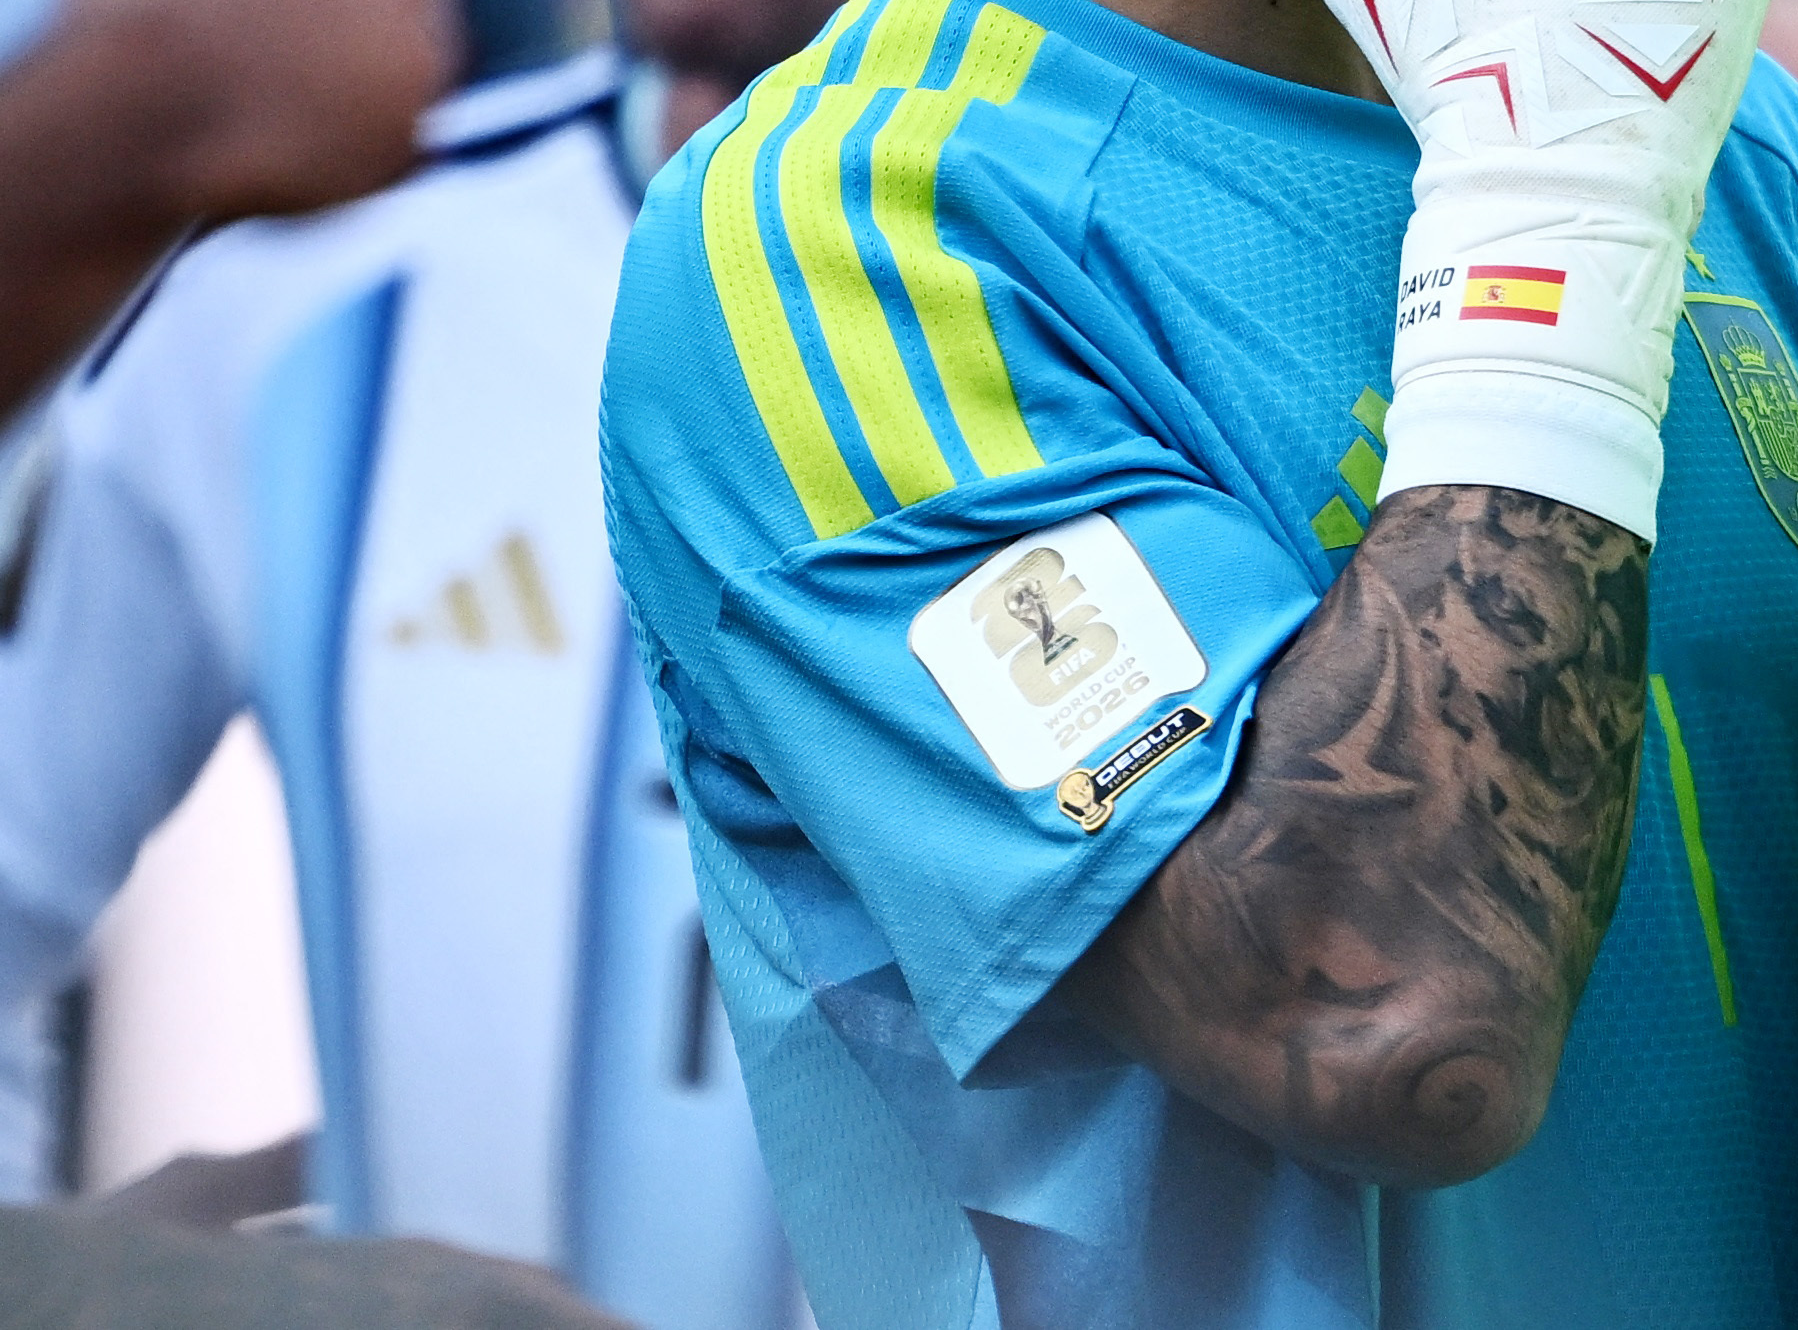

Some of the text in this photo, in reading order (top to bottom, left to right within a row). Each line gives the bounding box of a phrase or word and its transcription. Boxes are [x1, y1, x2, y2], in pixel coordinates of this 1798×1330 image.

[1400, 266, 1455, 304] DAVID
[1397, 299, 1441, 335] RAYA
[1044, 656, 1136, 730] WORLD CUP
[1048, 646, 1097, 686] FIFA
[1054, 670, 1150, 751] 2026
[1095, 712, 1185, 787] DEBUT
[1107, 726, 1188, 789] FIFA WORLD CUP
